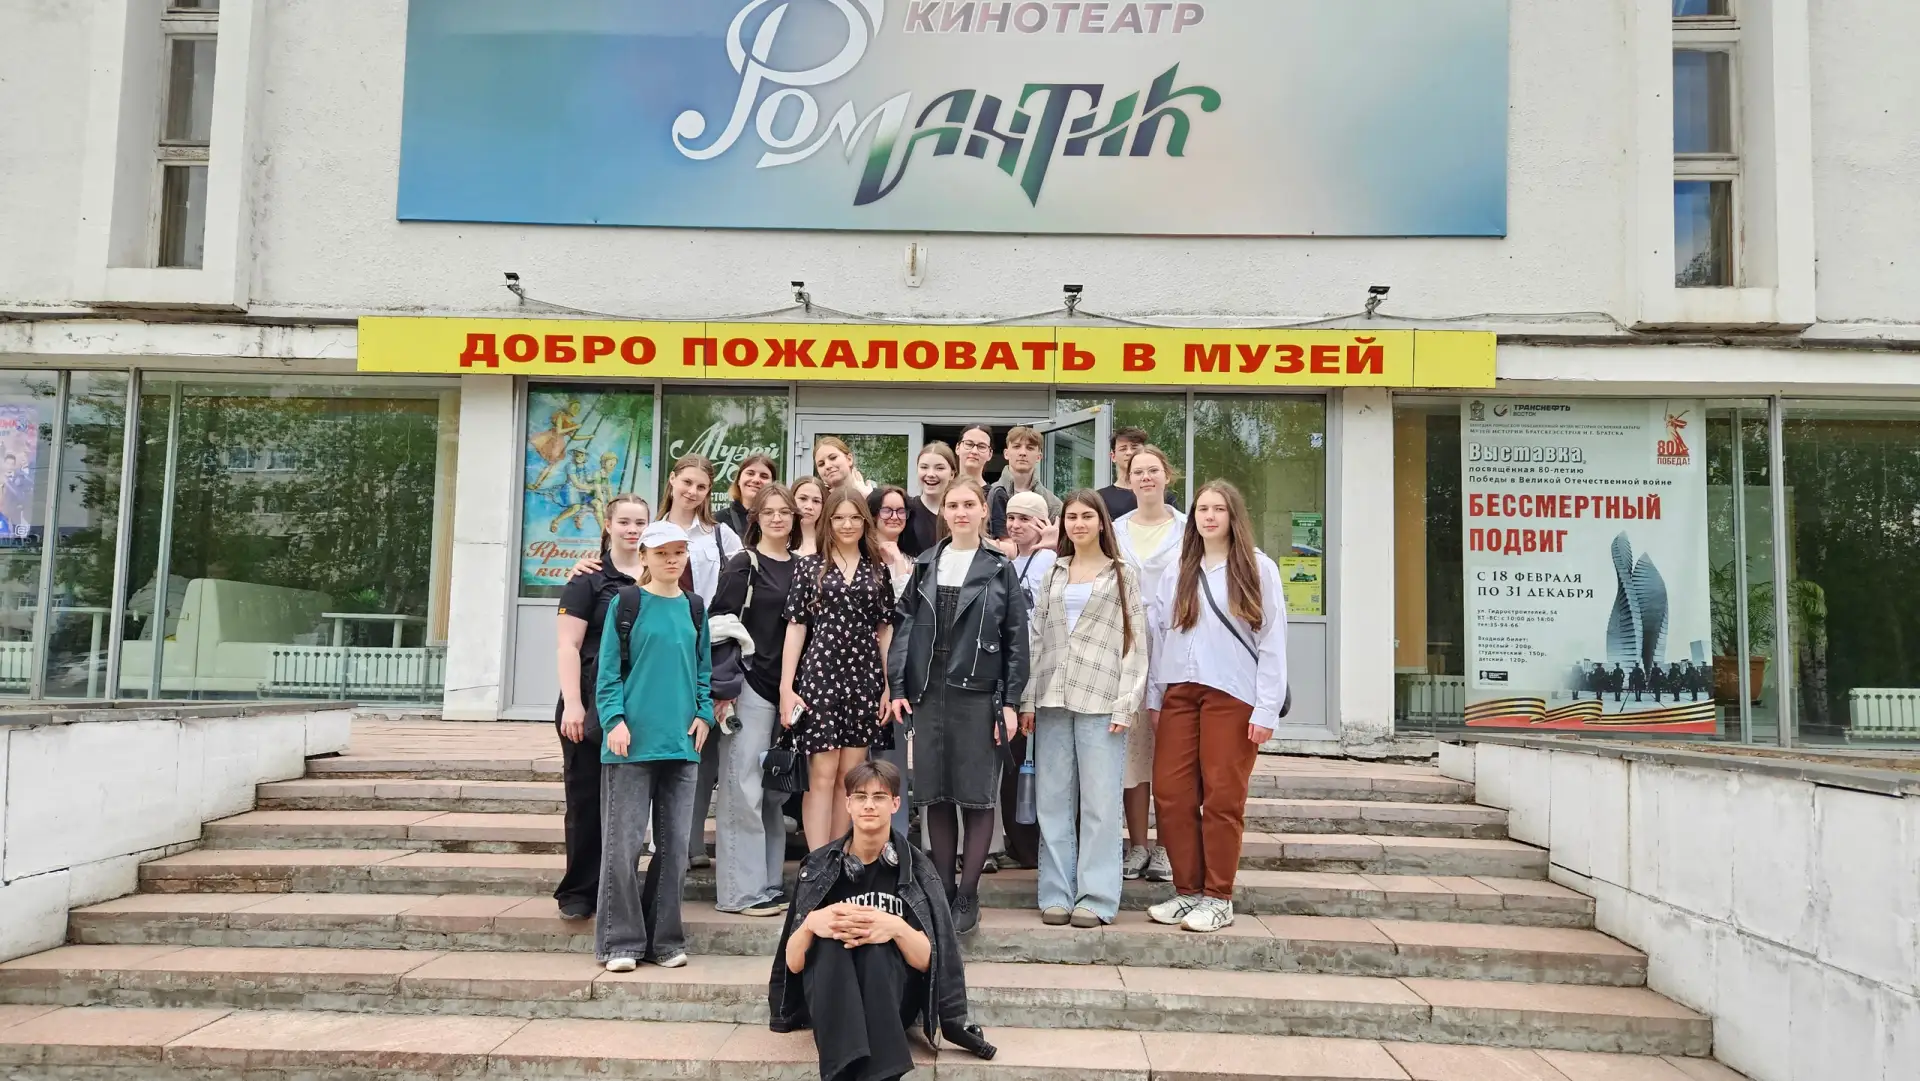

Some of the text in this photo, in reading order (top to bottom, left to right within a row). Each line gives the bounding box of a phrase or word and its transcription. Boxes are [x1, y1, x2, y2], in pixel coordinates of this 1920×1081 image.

[903, 1, 1205, 34] КИНОТЕАТР
[459, 333, 1384, 375] ДОБРО ПОЖАЛОВАТЬ В МУЗЕЙ
[670, 420, 780, 481] Музей
[1657, 440, 1674, 455] 80
[1657, 458, 1690, 466] ПОБЕДА!
[1469, 475, 1507, 484] Победы
[1564, 477, 1640, 485] Отечественной
[1469, 493, 1661, 520] БЕССМЕРТНЫЙ
[1469, 528, 1568, 556] ПОДВИГ
[1477, 571, 1582, 583] С 18 ФЕВРАЛЯ
[1478, 586, 1594, 598] ПО 31 ДЕКАБРЯ
